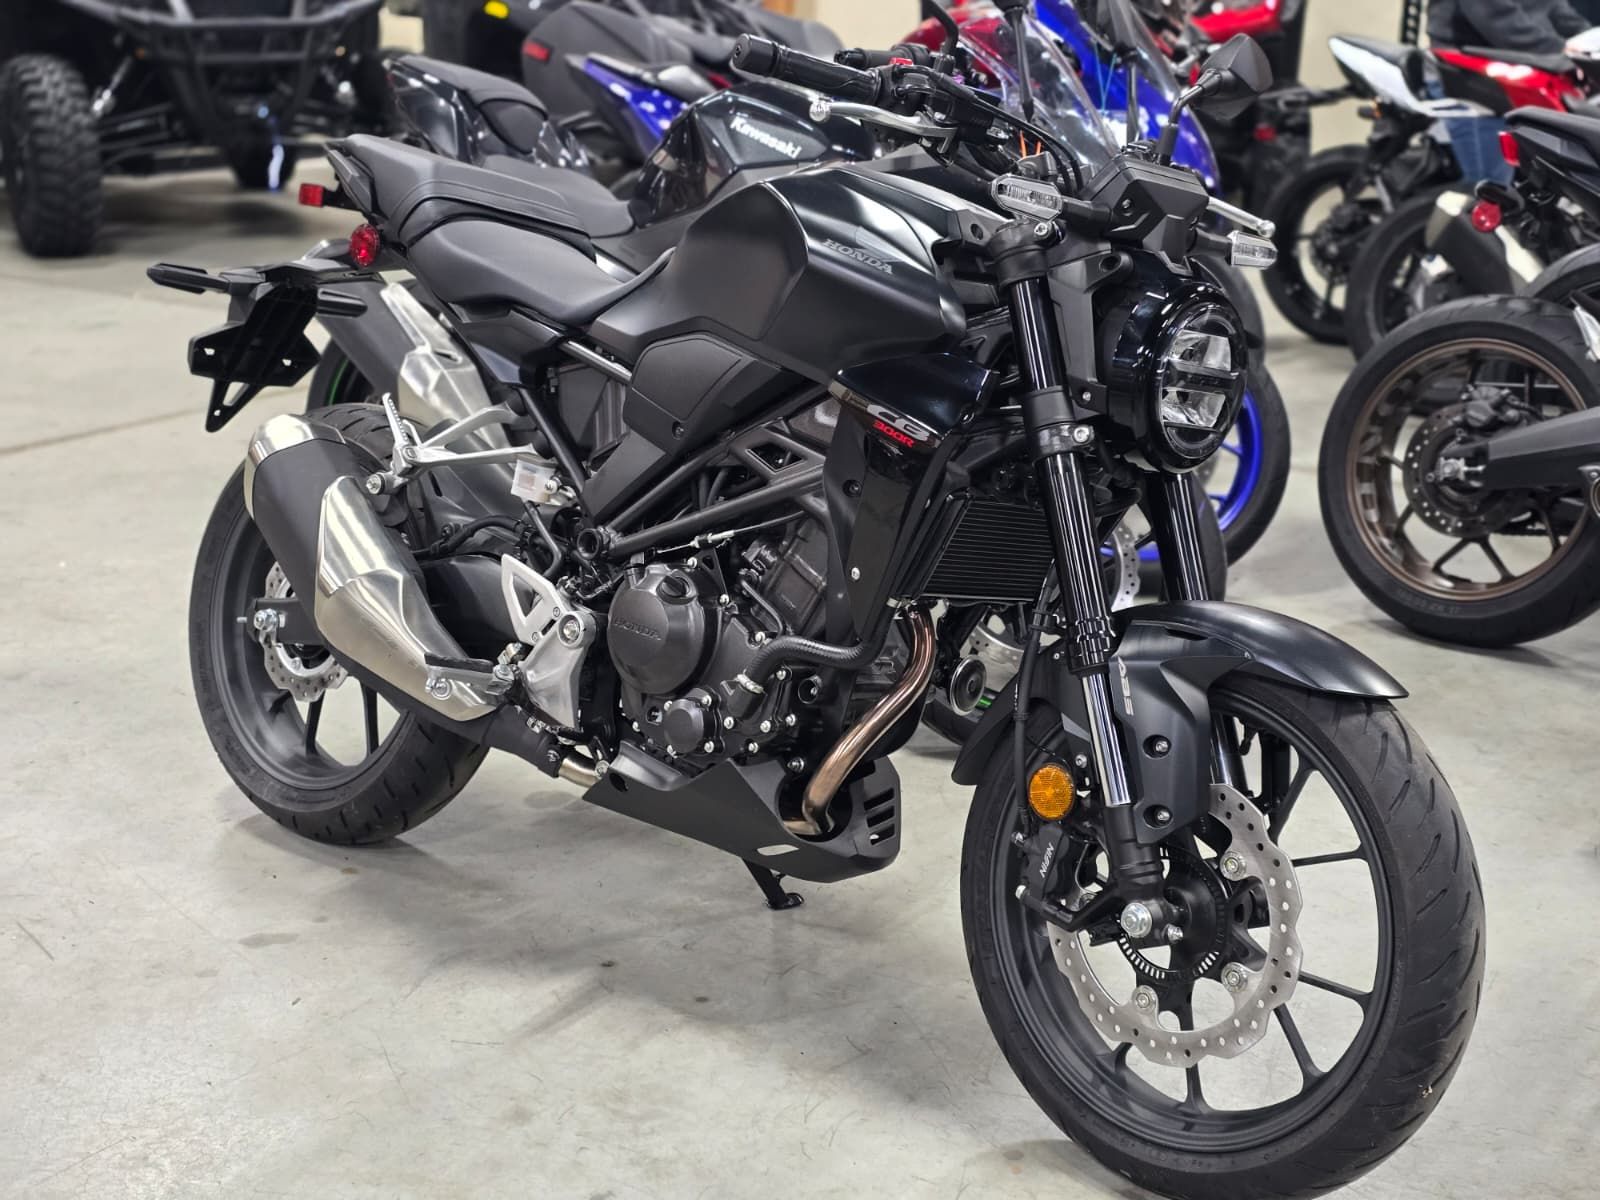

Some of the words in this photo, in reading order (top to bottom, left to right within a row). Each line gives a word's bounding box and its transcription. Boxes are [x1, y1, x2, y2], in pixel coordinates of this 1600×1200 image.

[730, 114, 802, 159] Kawasaki
[822, 238, 893, 275] HONDA
[866, 404, 930, 442] CB
[872, 419, 915, 449] 300R
[612, 614, 662, 641] HONDA
[1117, 656, 1135, 717] ABS
